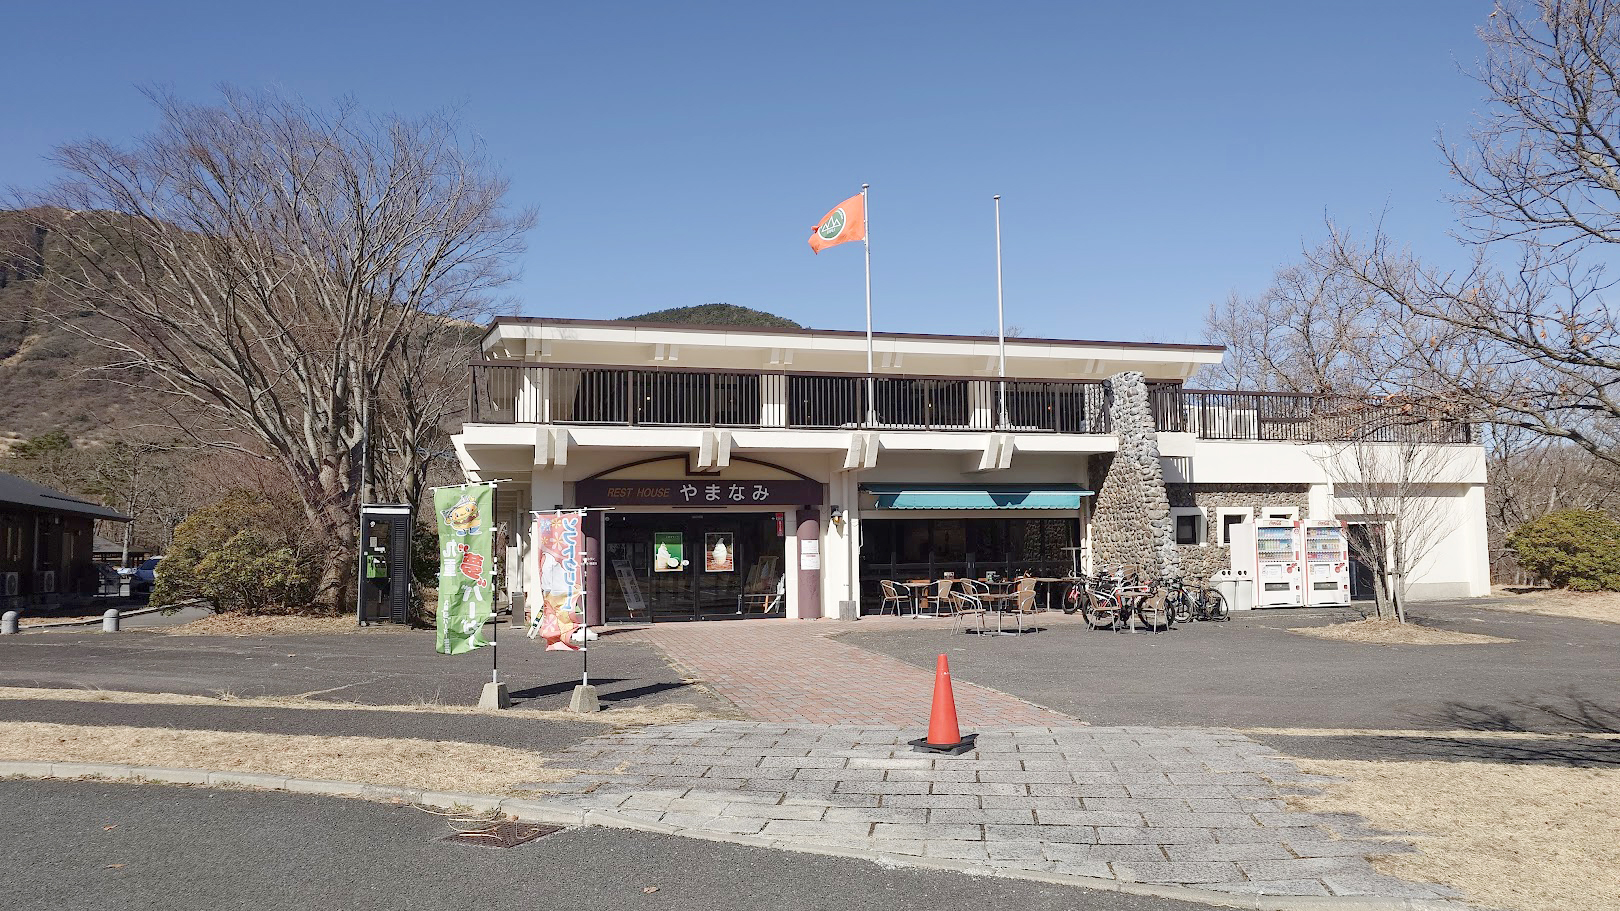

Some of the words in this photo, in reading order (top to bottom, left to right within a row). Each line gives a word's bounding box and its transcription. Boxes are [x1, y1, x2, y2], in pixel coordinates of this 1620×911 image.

[607, 487, 633, 498] REST
[636, 487, 671, 498] HOUSE
[679, 483, 770, 502] やまなみ
